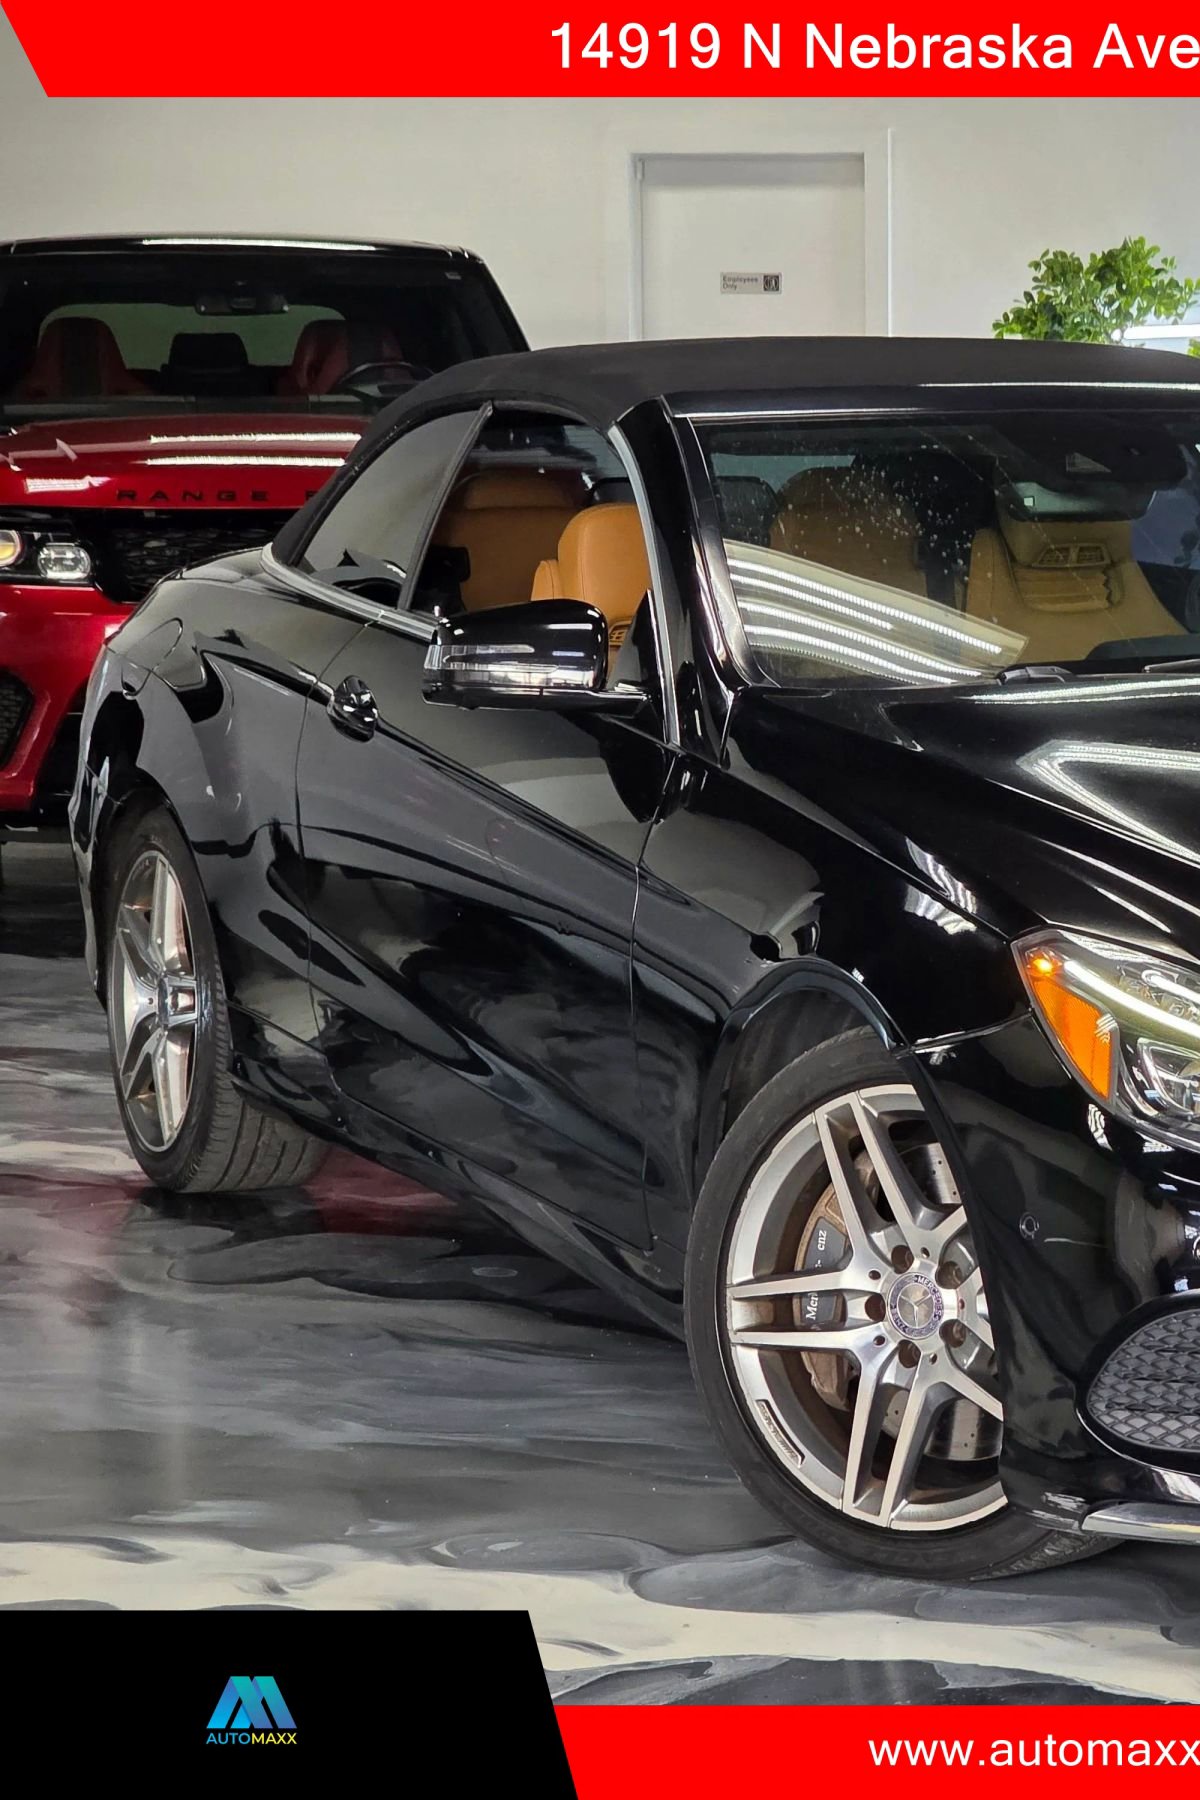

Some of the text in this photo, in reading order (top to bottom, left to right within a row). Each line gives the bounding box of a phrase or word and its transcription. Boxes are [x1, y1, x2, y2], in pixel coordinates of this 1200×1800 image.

[722, 275, 758, 284] Employees
[722, 283, 738, 291] Only
[116, 488, 268, 501] RANGE
[917, 1275, 942, 1315] MERCEDES
